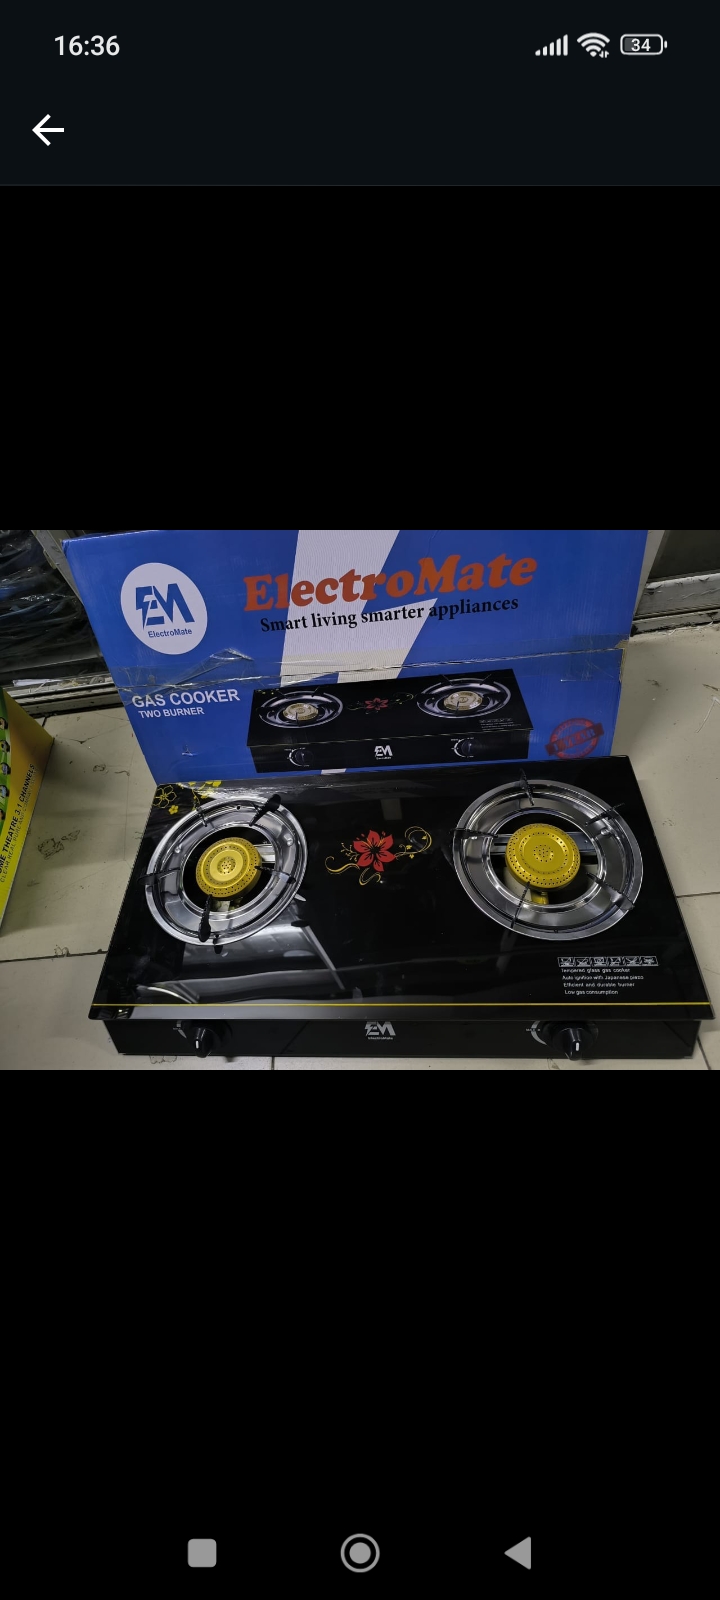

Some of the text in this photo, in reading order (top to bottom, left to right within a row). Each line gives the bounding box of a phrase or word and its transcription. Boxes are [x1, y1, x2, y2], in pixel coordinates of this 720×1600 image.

[243, 553, 538, 612] ElectroMate
[260, 598, 519, 632] Smart living smarter appliances
[147, 628, 193, 638] ElectroMate
[131, 688, 241, 708] GAS COOKER
[138, 706, 205, 719] TWO BURNER
[2, 816, 18, 852] THEATRE
[19, 763, 35, 802] CHANNELS
